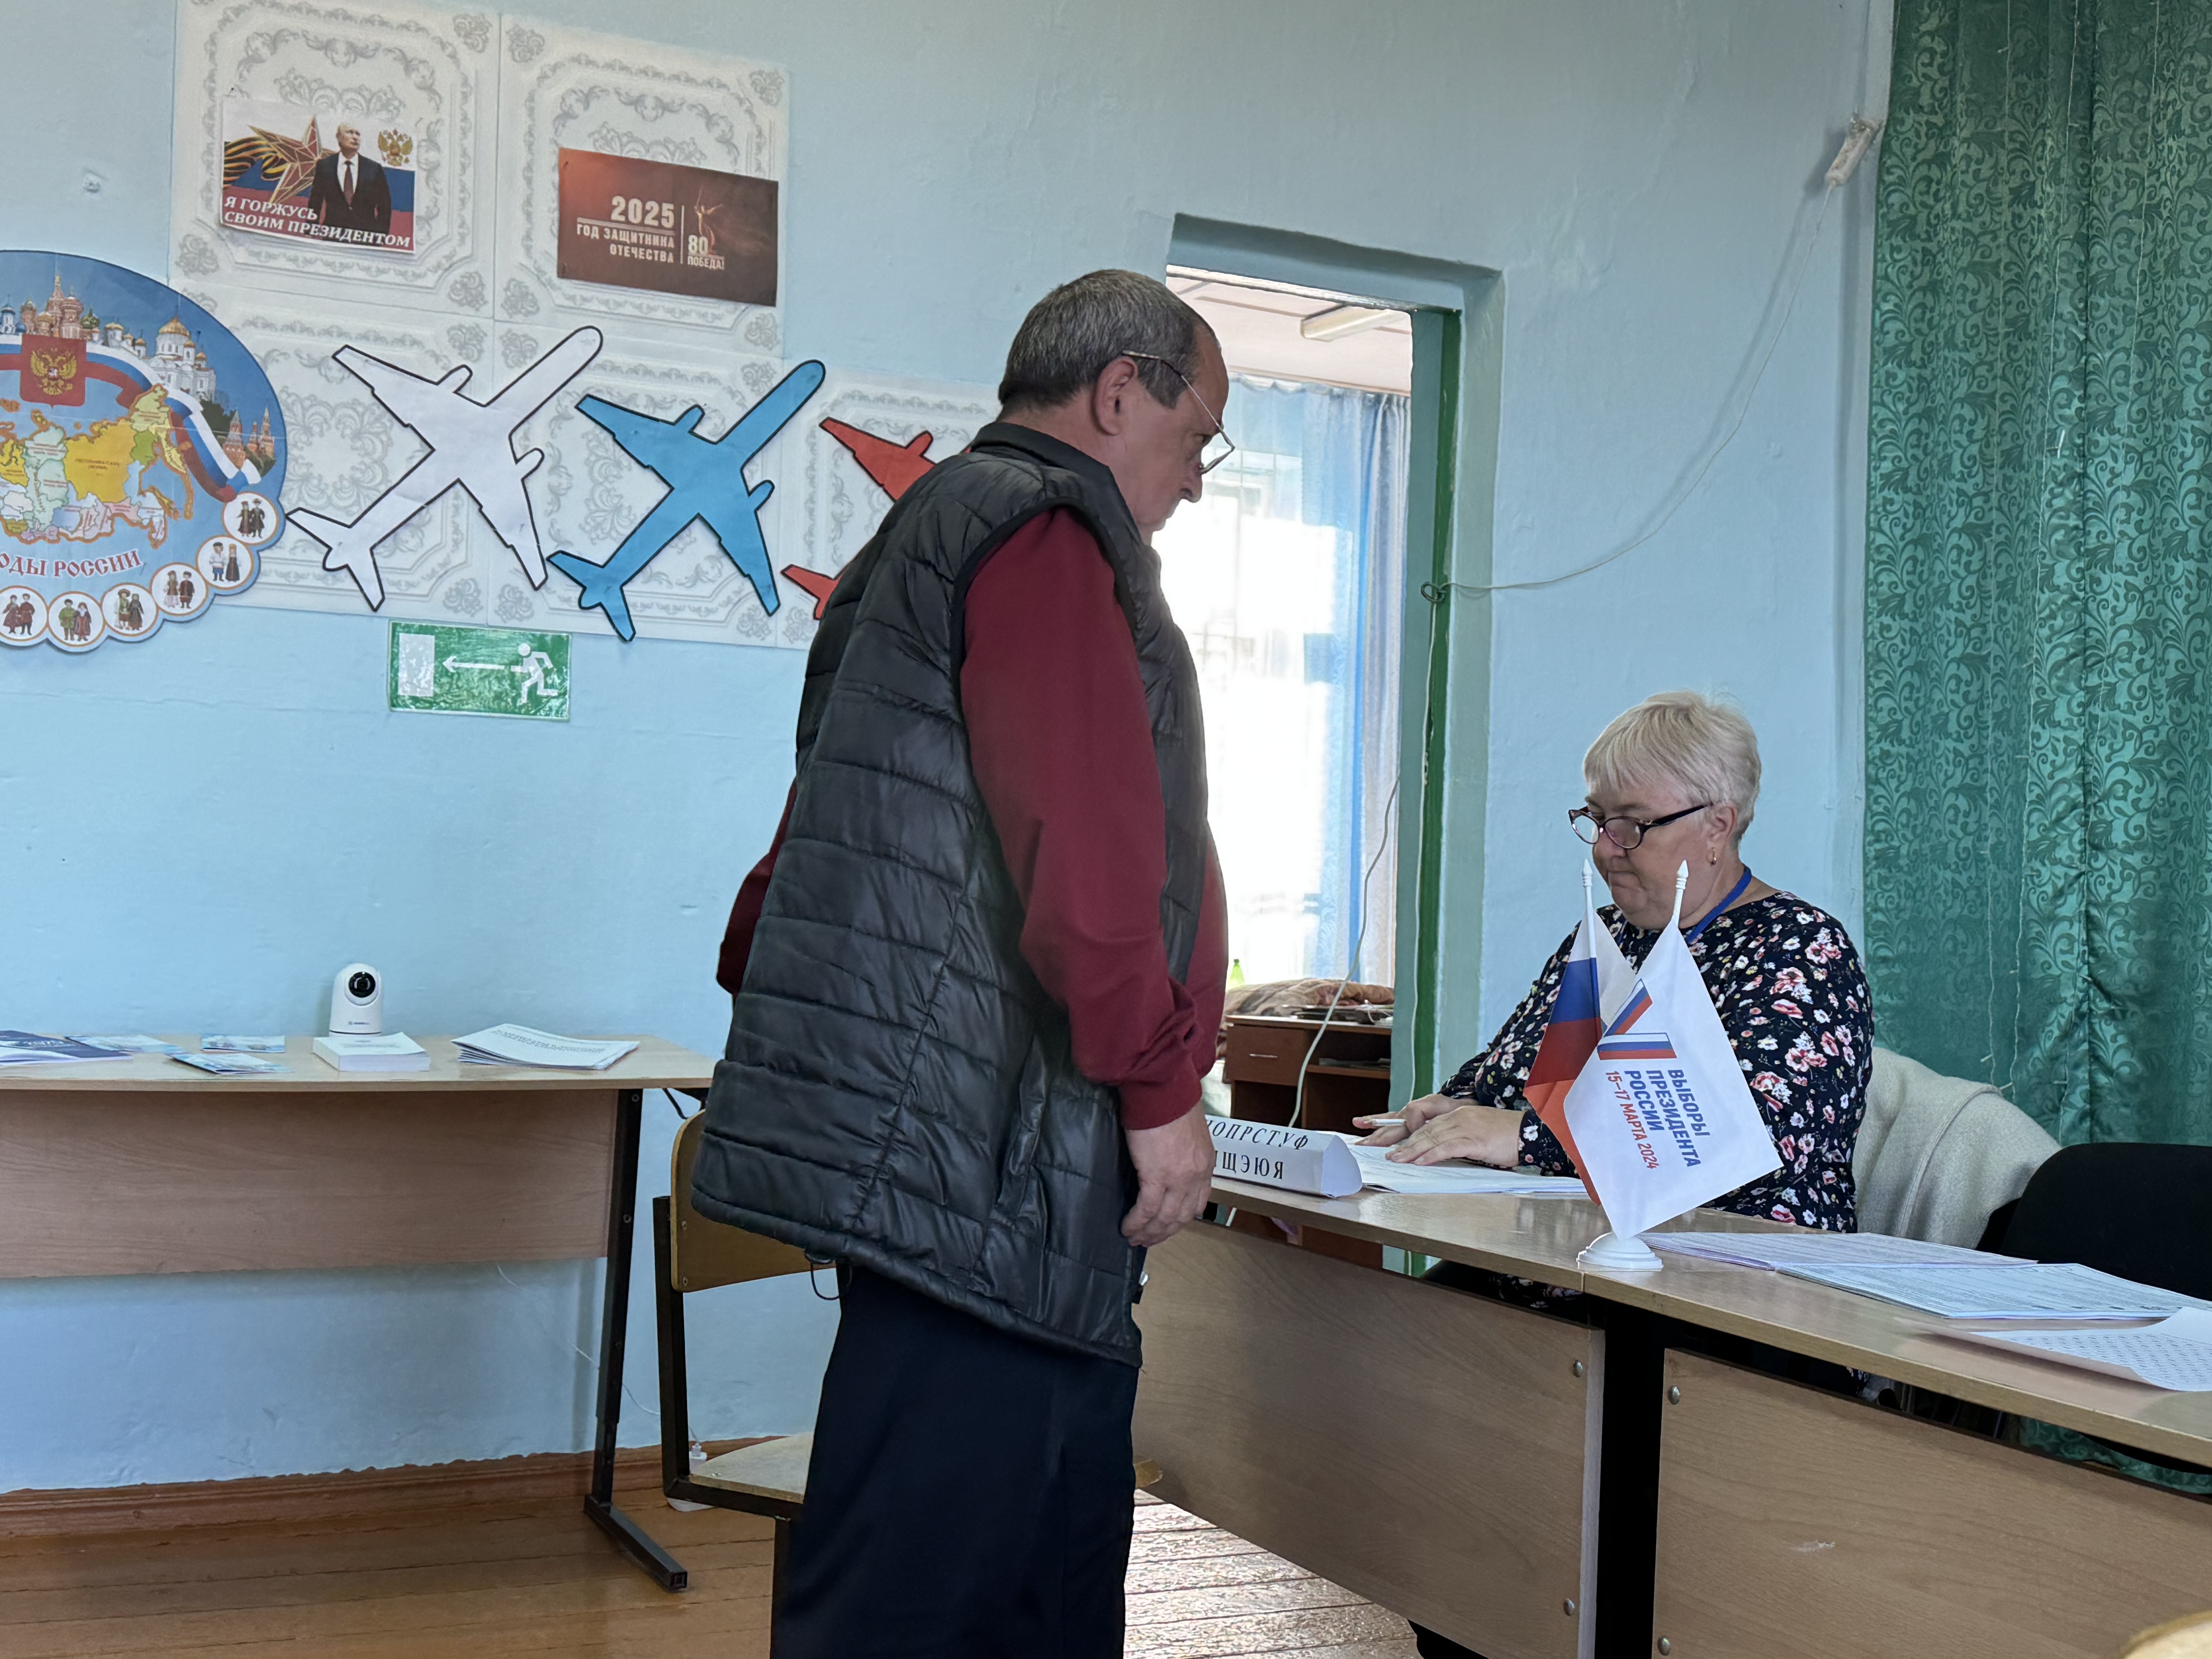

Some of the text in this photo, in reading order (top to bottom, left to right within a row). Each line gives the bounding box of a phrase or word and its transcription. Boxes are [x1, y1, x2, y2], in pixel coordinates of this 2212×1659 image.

[224, 196, 318, 220] Я ГОРЖУСЬ
[611, 196, 675, 228] 2025
[224, 211, 410, 247] СВОИМ ПРЕЗИДЕНТОМ
[577, 223, 675, 248] ГОД ЗАЩИТНИКА
[688, 234, 708, 254] 80
[610, 243, 674, 263] ОТЕЧЕСТВА
[687, 256, 725, 270] ПОБЕДА!
[53, 550, 142, 577] РОССИИ
[1624, 1071, 1665, 1130] РОССИИ
[1668, 1069, 1711, 1136] ВЫБОРЫ
[1646, 1070, 1701, 1167] ПРЕЗИДЕНТА
[1620, 1104, 1648, 1140] МАРТА
[1637, 1143, 1659, 1169] 2024
[1215, 1150, 1284, 1180] ЩЭЮЯ
